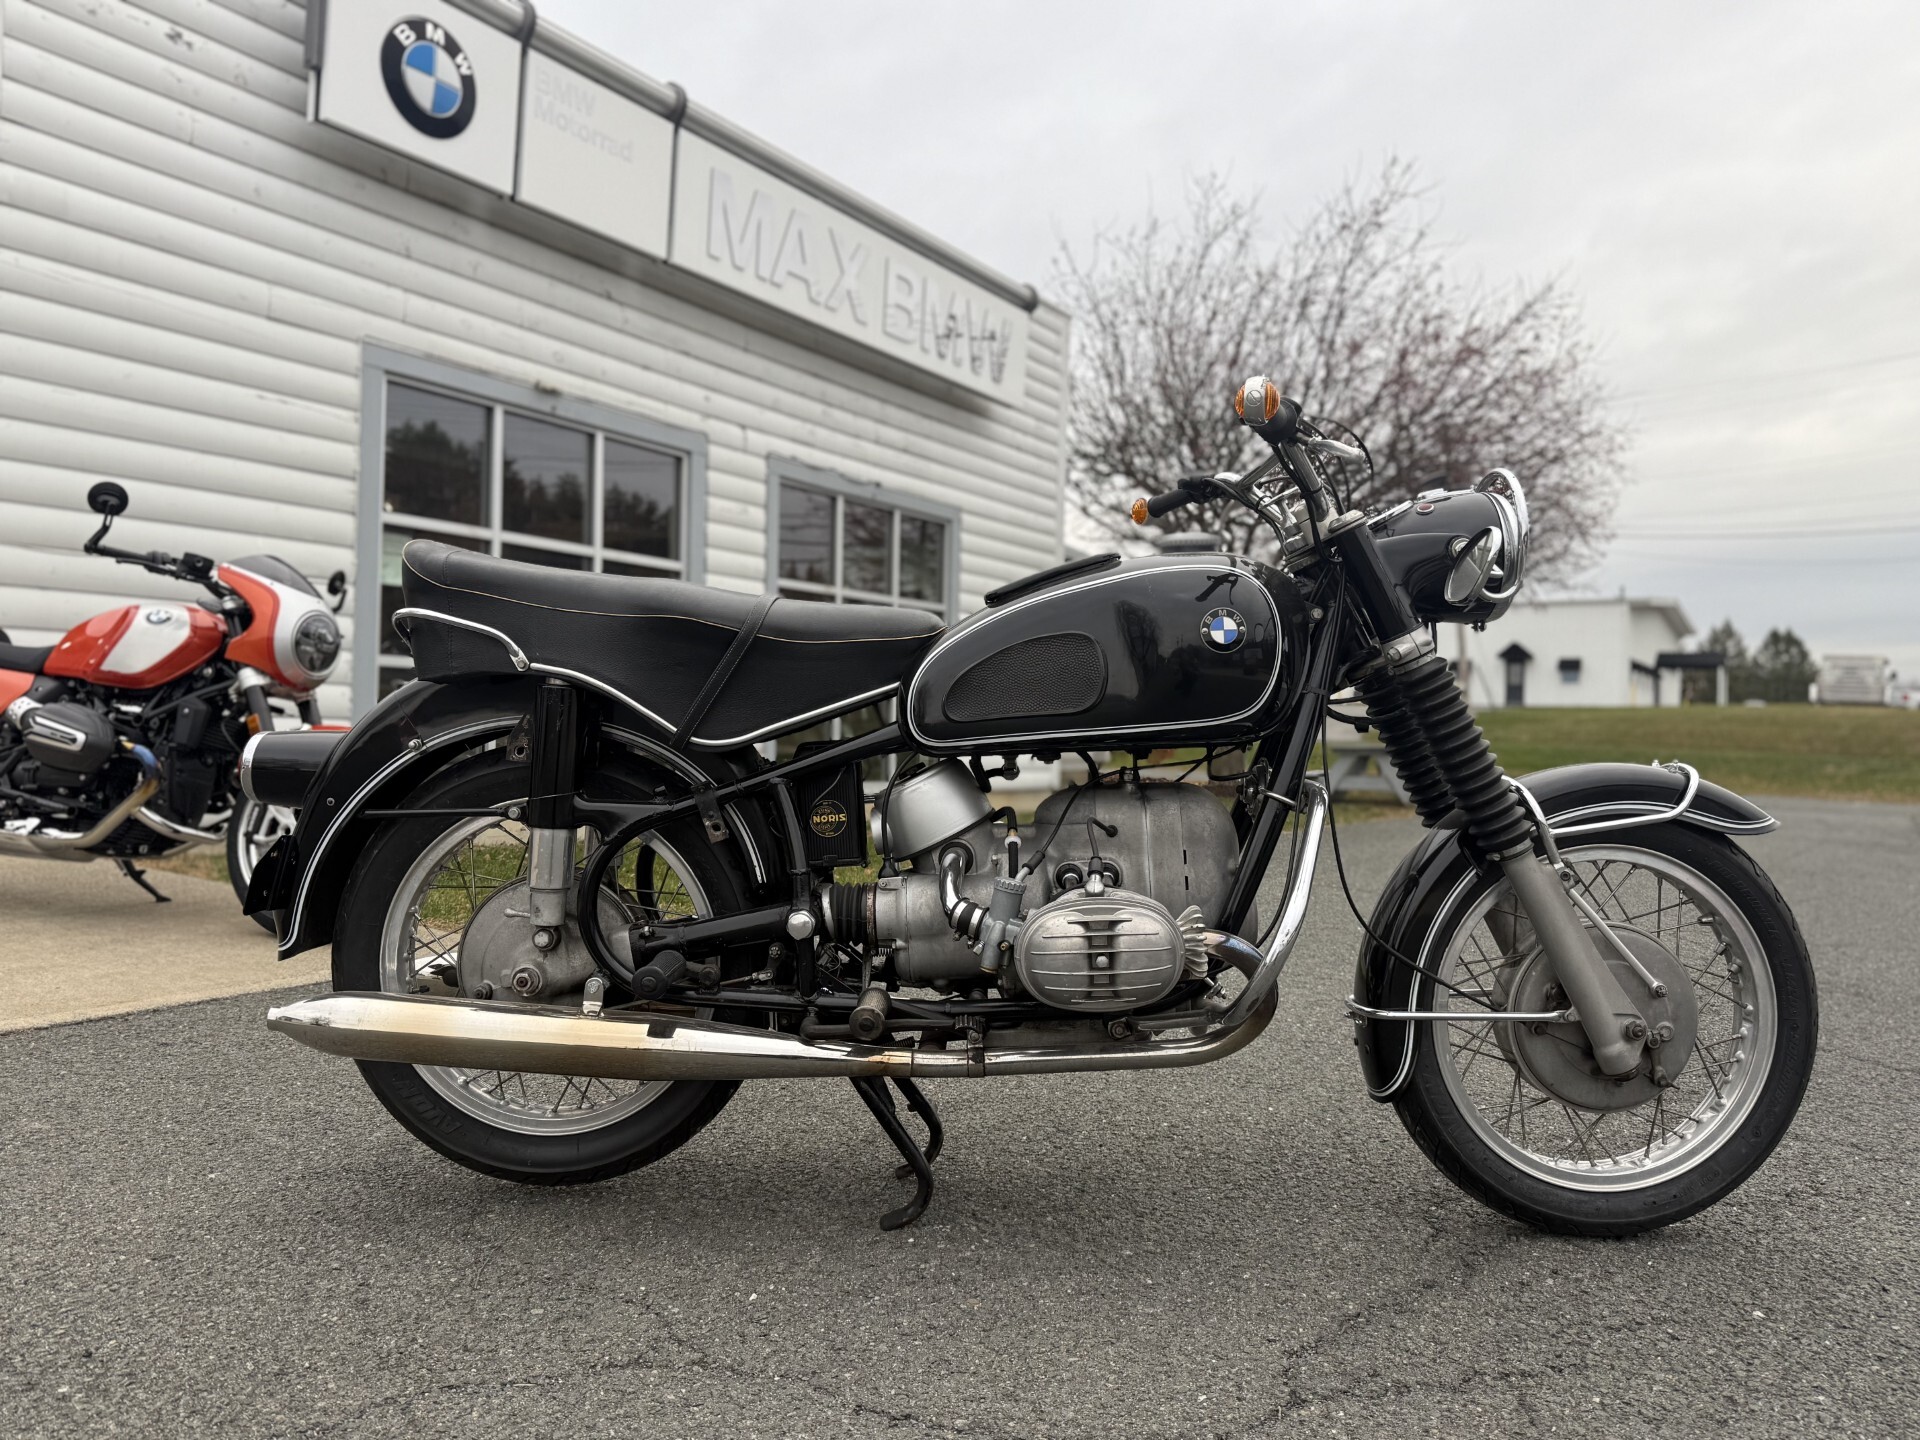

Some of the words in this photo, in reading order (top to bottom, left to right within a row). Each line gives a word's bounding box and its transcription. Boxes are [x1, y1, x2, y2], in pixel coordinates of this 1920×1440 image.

[392, 21, 473, 77] BMW
[706, 166, 871, 328] MAX
[881, 255, 1013, 385] BMW
[1204, 609, 1242, 625] BMW
[812, 813, 846, 824] NORIS
